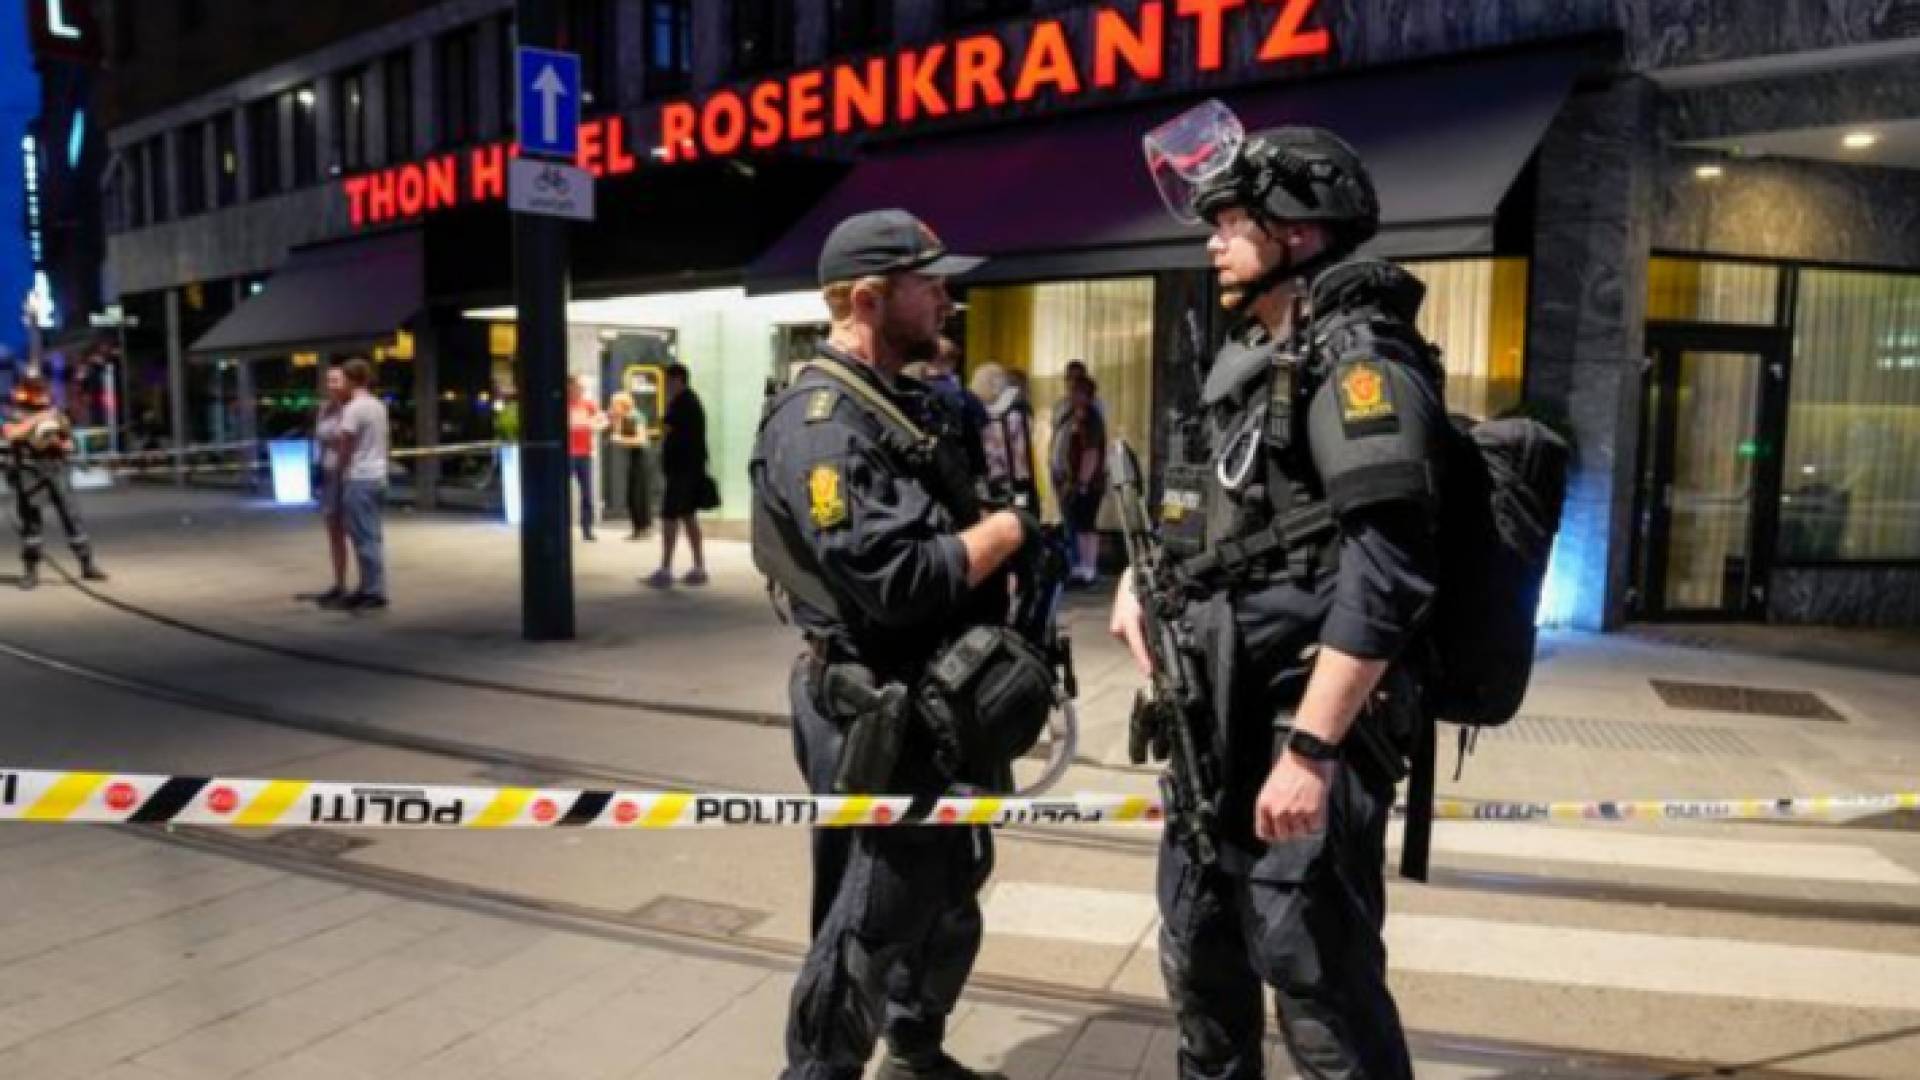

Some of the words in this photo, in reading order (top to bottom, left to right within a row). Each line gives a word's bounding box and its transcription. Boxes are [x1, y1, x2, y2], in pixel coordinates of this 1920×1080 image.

[345, 153, 456, 224] THON
[471, 115, 635, 200] HEL
[660, 0, 1330, 162] ROSENKRANTZ
[310, 794, 463, 824] POLITI
[695, 799, 818, 825] POLITI
